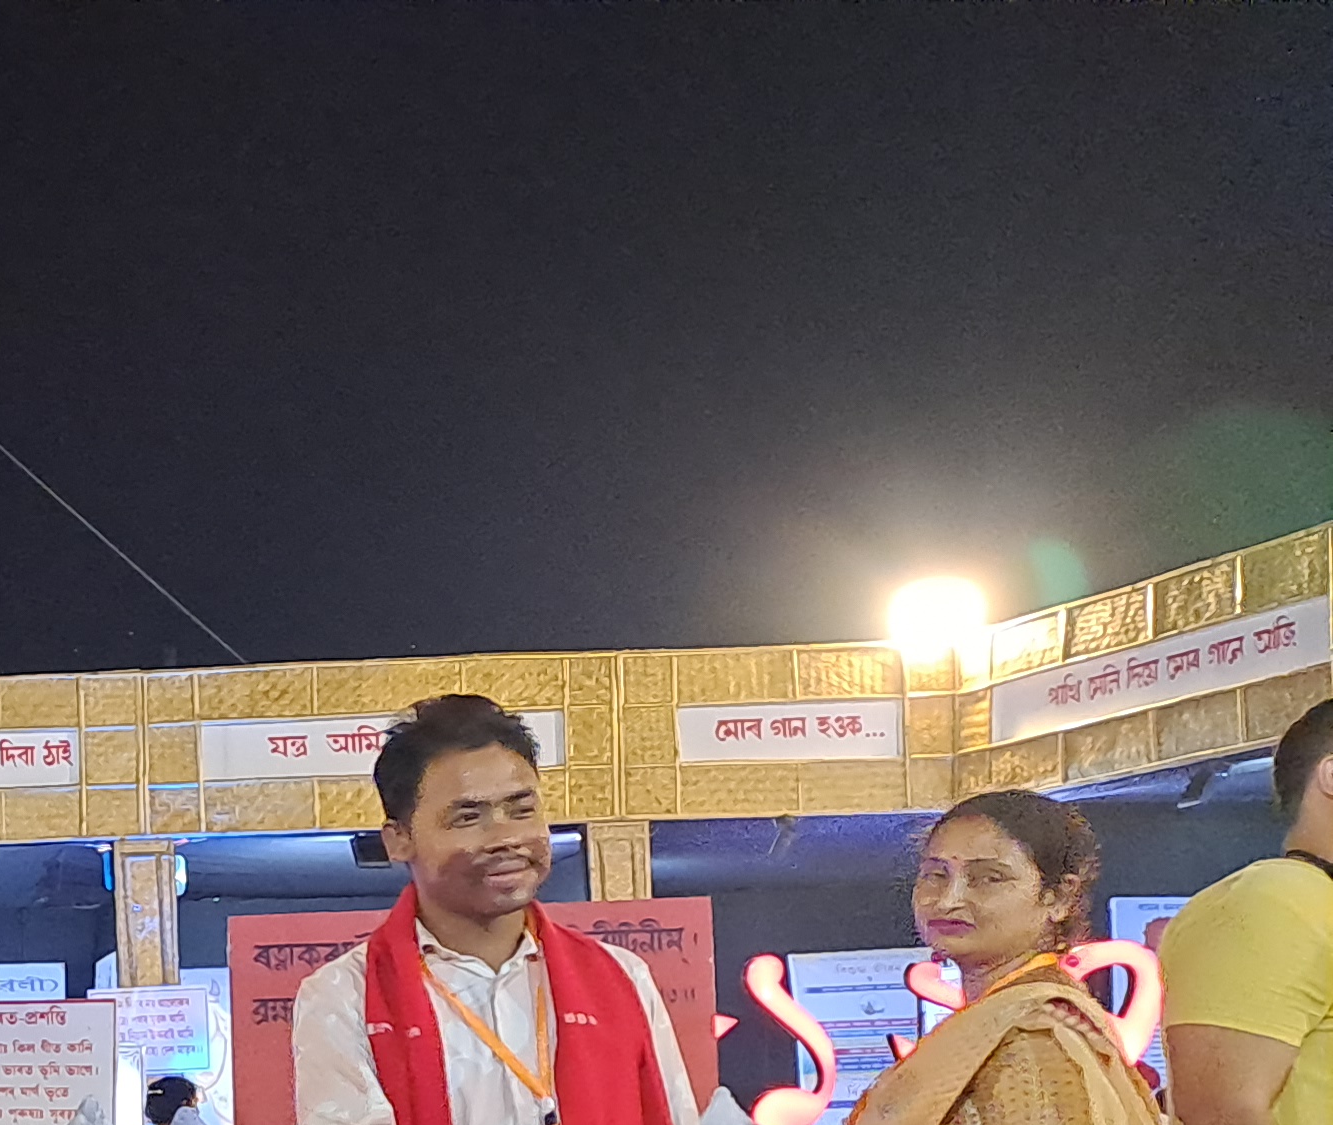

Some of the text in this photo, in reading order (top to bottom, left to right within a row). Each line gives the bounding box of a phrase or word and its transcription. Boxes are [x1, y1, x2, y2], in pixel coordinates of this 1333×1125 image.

[715, 717, 763, 741] মোৰ
[770, 716, 807, 738] গান
[0, 738, 36, 768] দিবা
[42, 739, 74, 767] ঠাই
